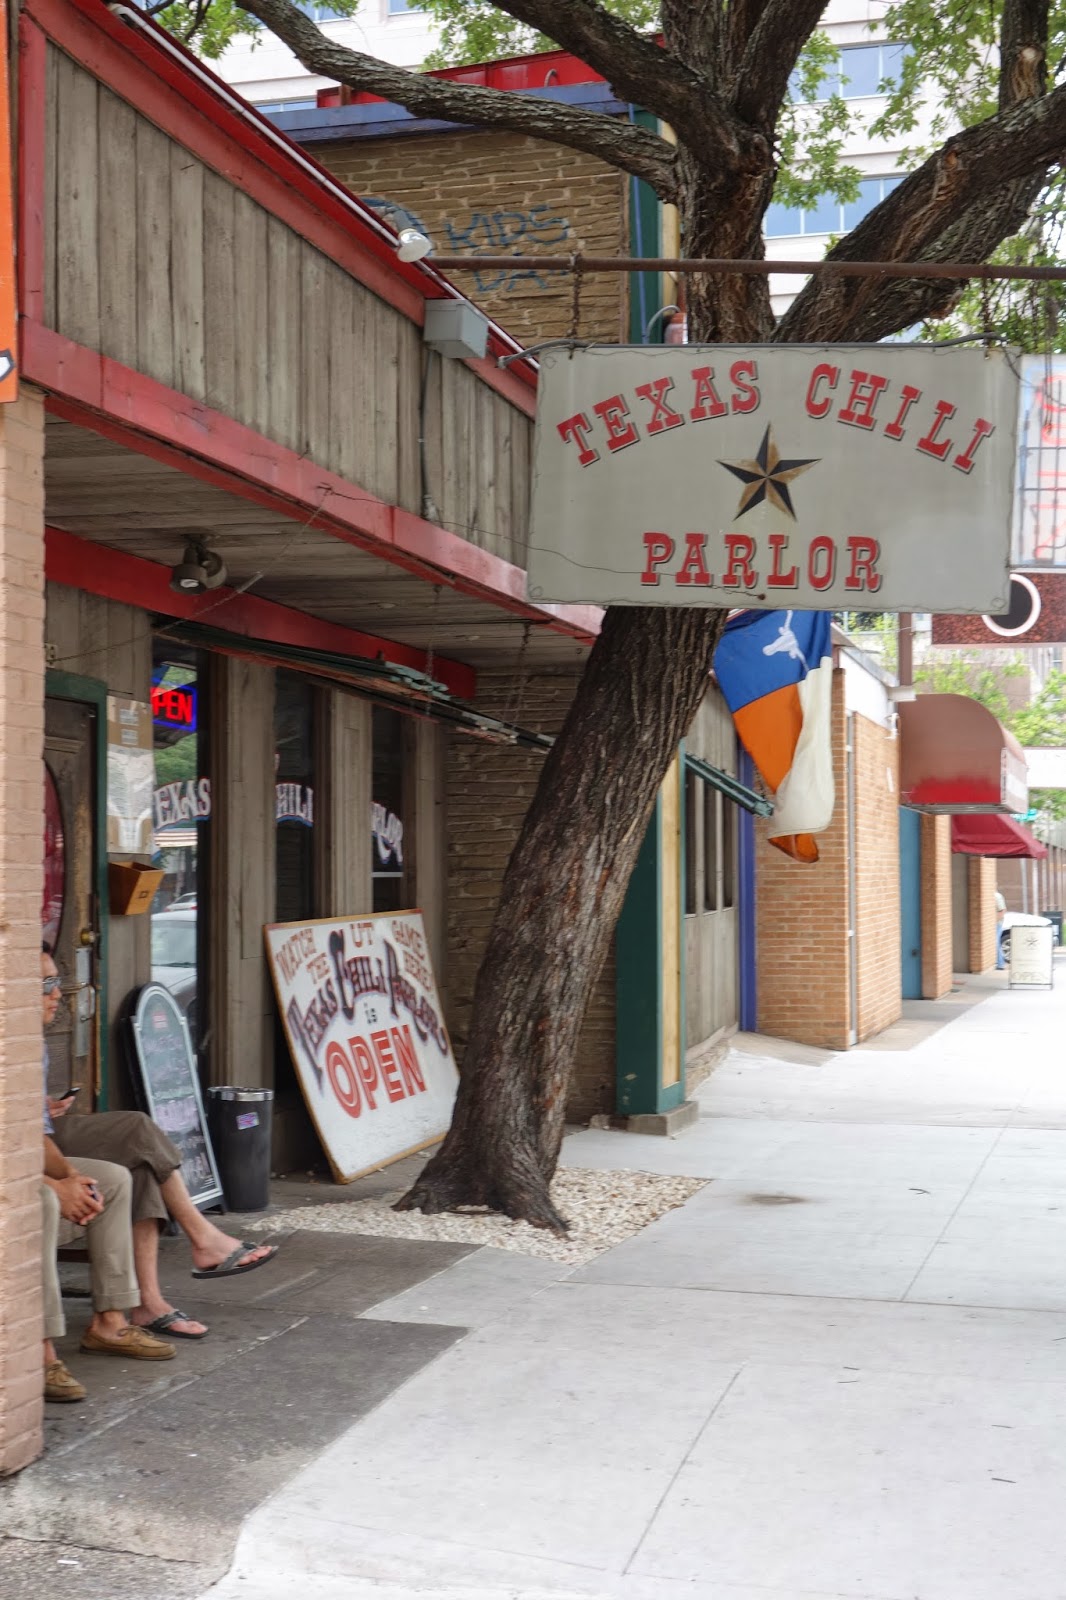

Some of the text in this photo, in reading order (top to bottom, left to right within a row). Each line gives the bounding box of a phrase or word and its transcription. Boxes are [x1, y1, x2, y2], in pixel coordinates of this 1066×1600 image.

[445, 204, 570, 252] KIDS
[556, 360, 761, 468] TEXAS
[804, 363, 995, 474] CHILI
[640, 532, 882, 592] PARLOR
[150, 687, 193, 724] PEN
[152, 777, 212, 829] EXAS
[275, 782, 314, 824] HILI
[276, 928, 316, 986] WATCH
[306, 952, 331, 985] THE
[287, 928, 450, 1094] TEXAS CHILI PARLOR
[325, 1024, 426, 1119] OPEN
